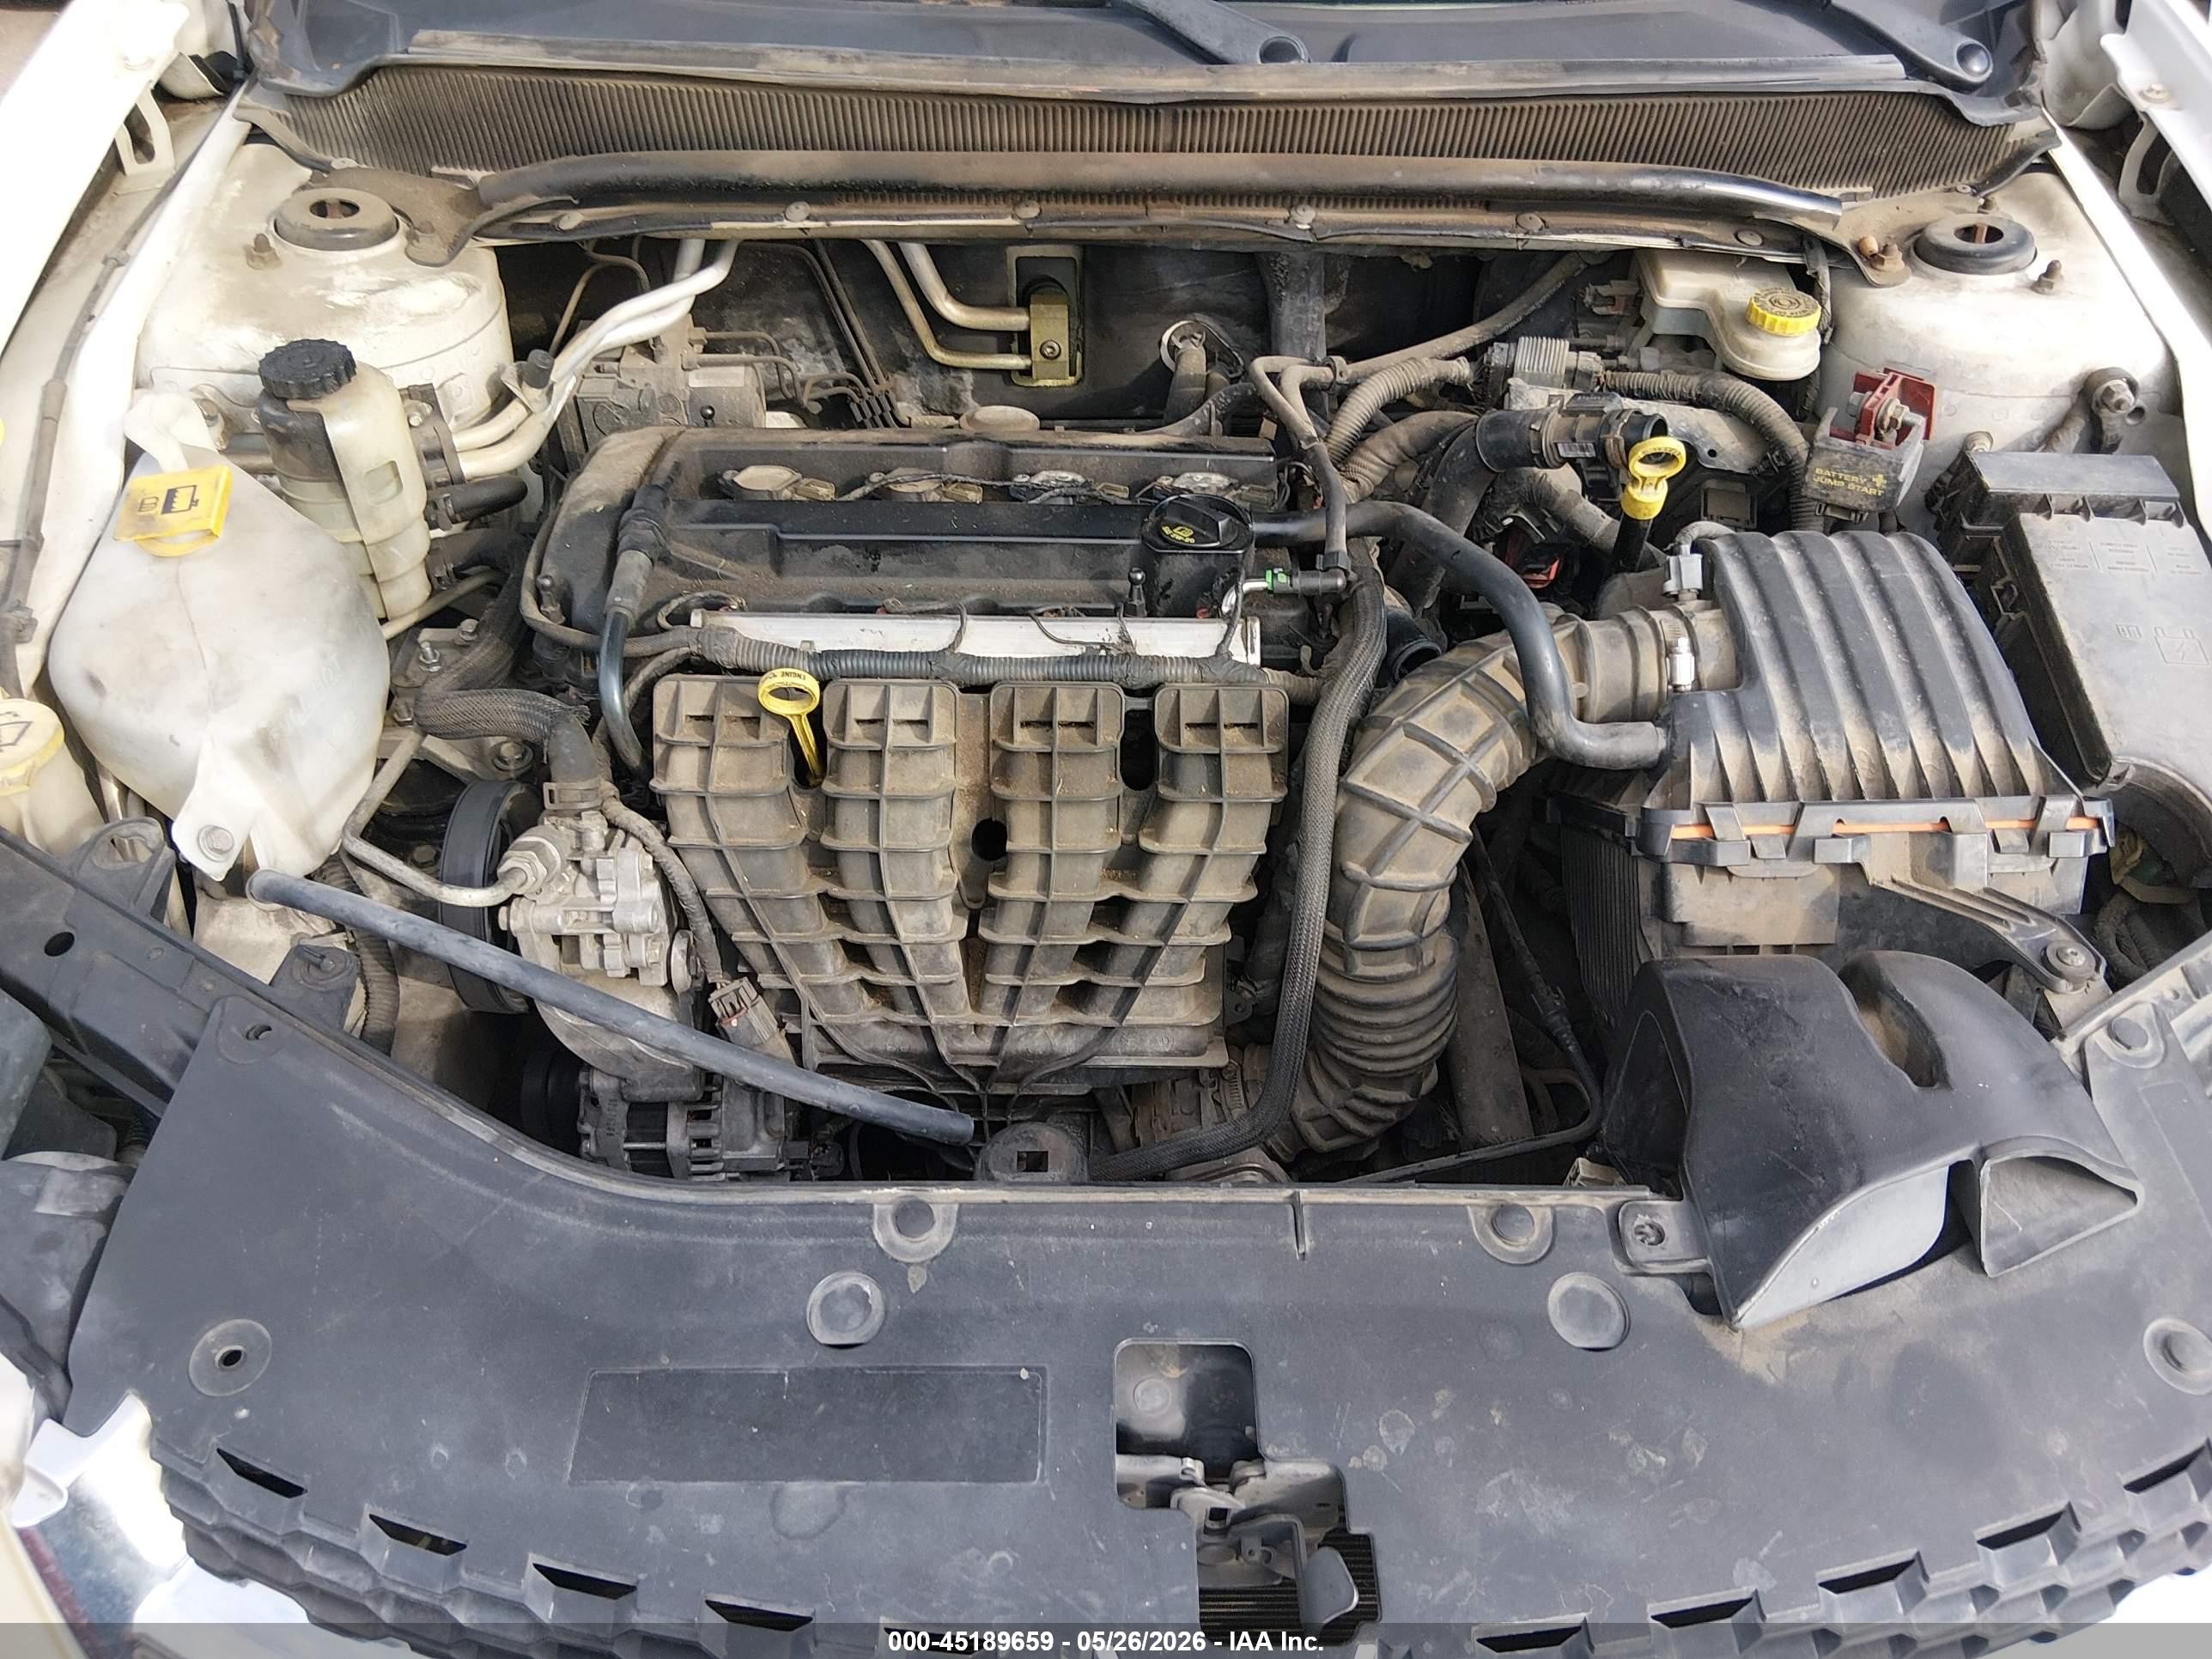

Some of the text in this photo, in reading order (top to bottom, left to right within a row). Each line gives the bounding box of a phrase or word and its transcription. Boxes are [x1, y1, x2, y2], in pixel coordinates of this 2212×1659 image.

[1814, 468, 1867, 483] BATTERY
[1813, 476, 1884, 496] JUMP START
[781, 672, 806, 680] ENGINE
